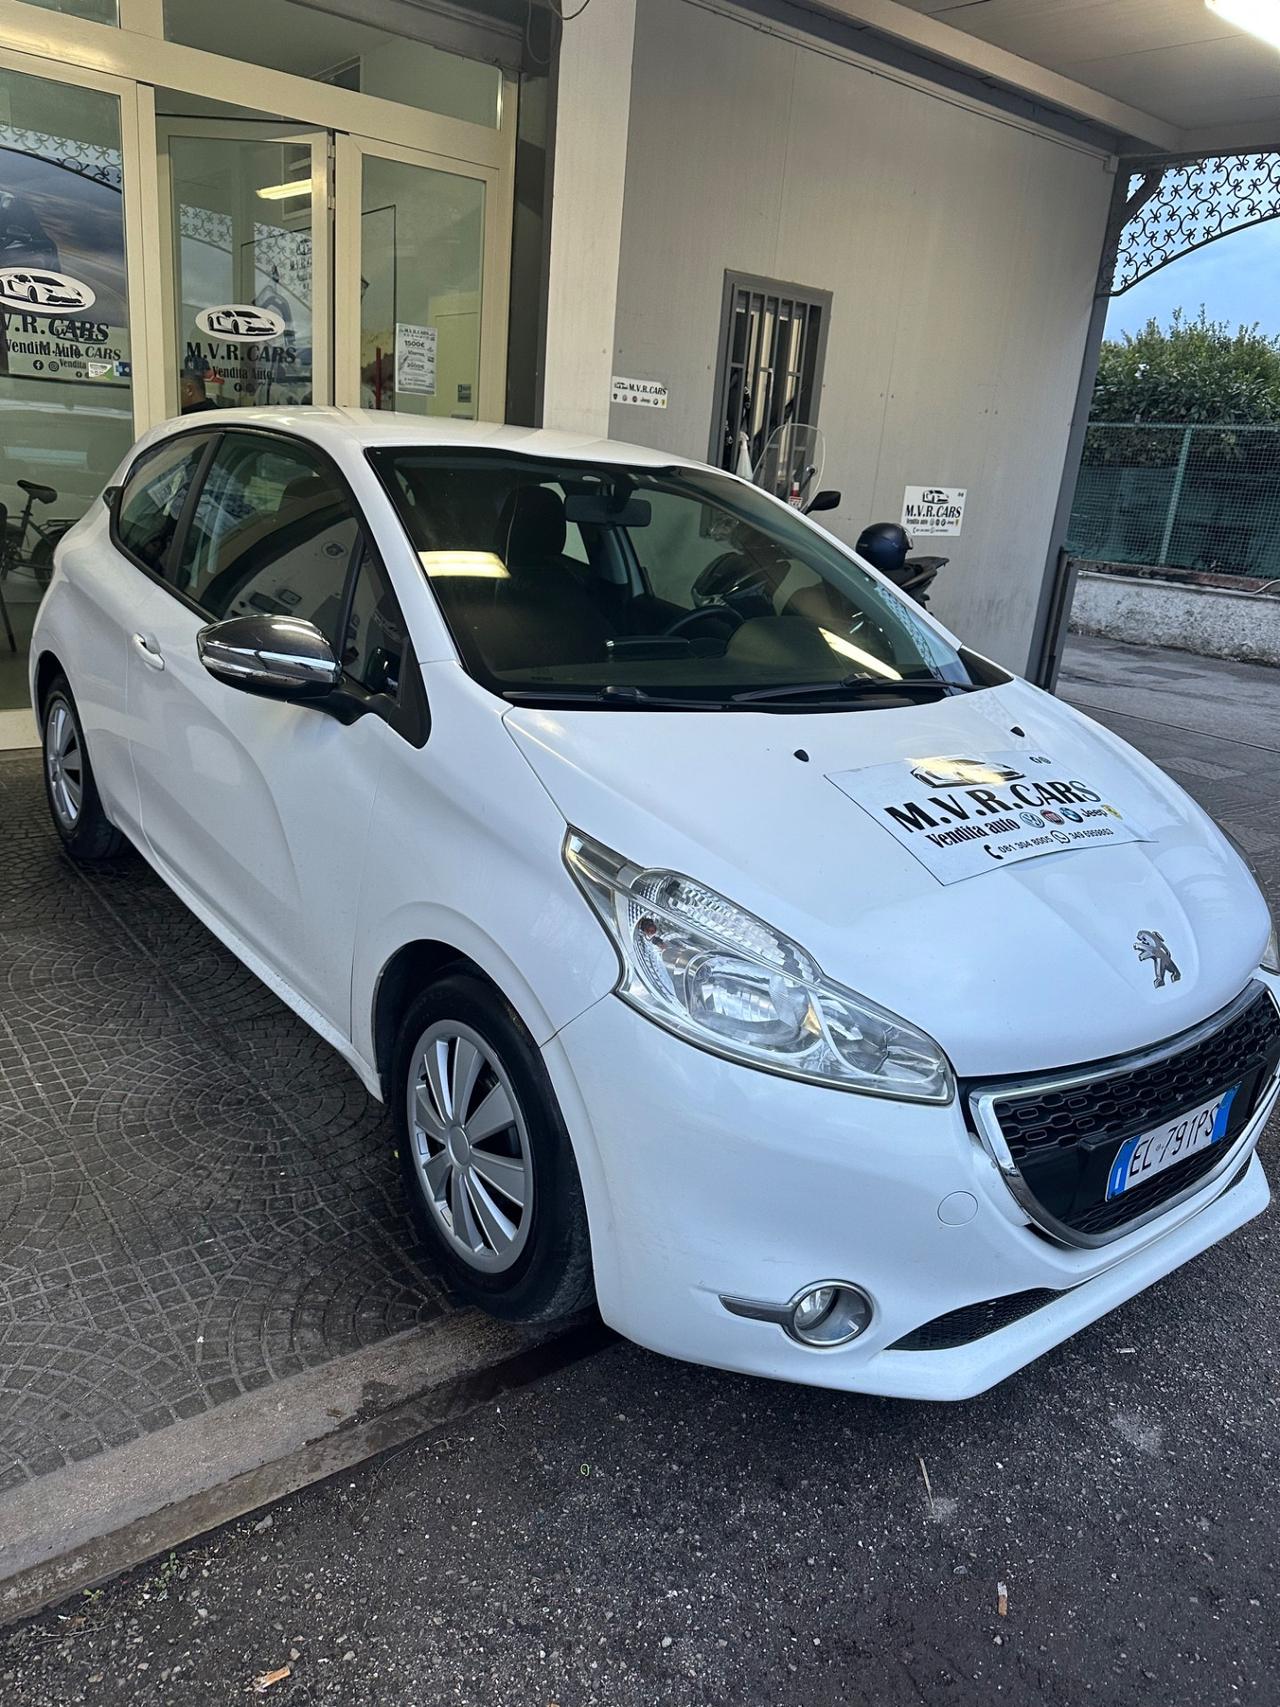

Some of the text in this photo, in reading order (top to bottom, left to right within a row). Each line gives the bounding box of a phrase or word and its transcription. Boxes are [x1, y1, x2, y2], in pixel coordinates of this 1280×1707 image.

[925, 808, 1109, 849] Vendita auto Jeep
[997, 844, 1017, 853] 081
